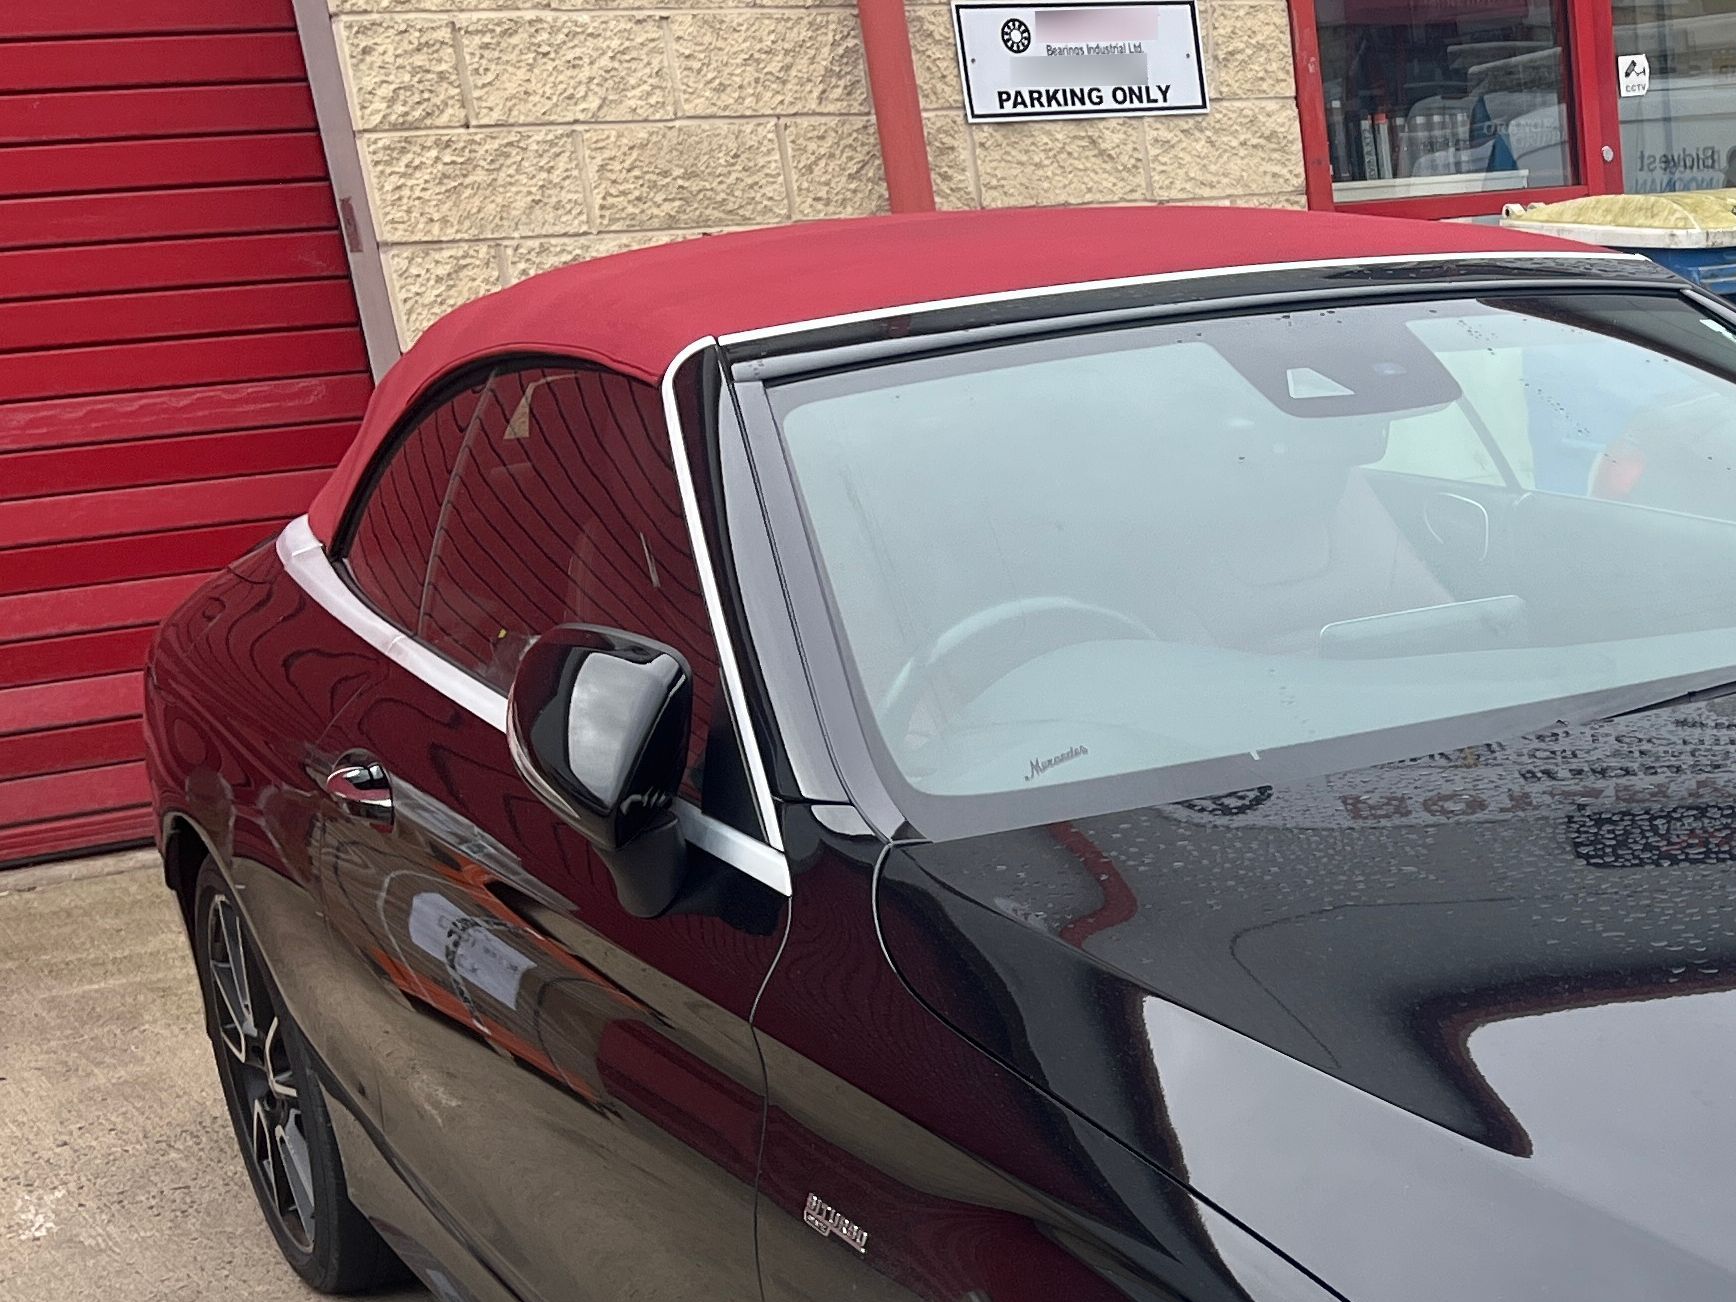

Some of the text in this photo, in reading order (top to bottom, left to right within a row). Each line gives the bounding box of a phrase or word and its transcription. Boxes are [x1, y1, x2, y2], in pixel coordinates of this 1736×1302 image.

[997, 84, 1171, 110] PARKING ONLY
[1625, 83, 1647, 93] CCTV
